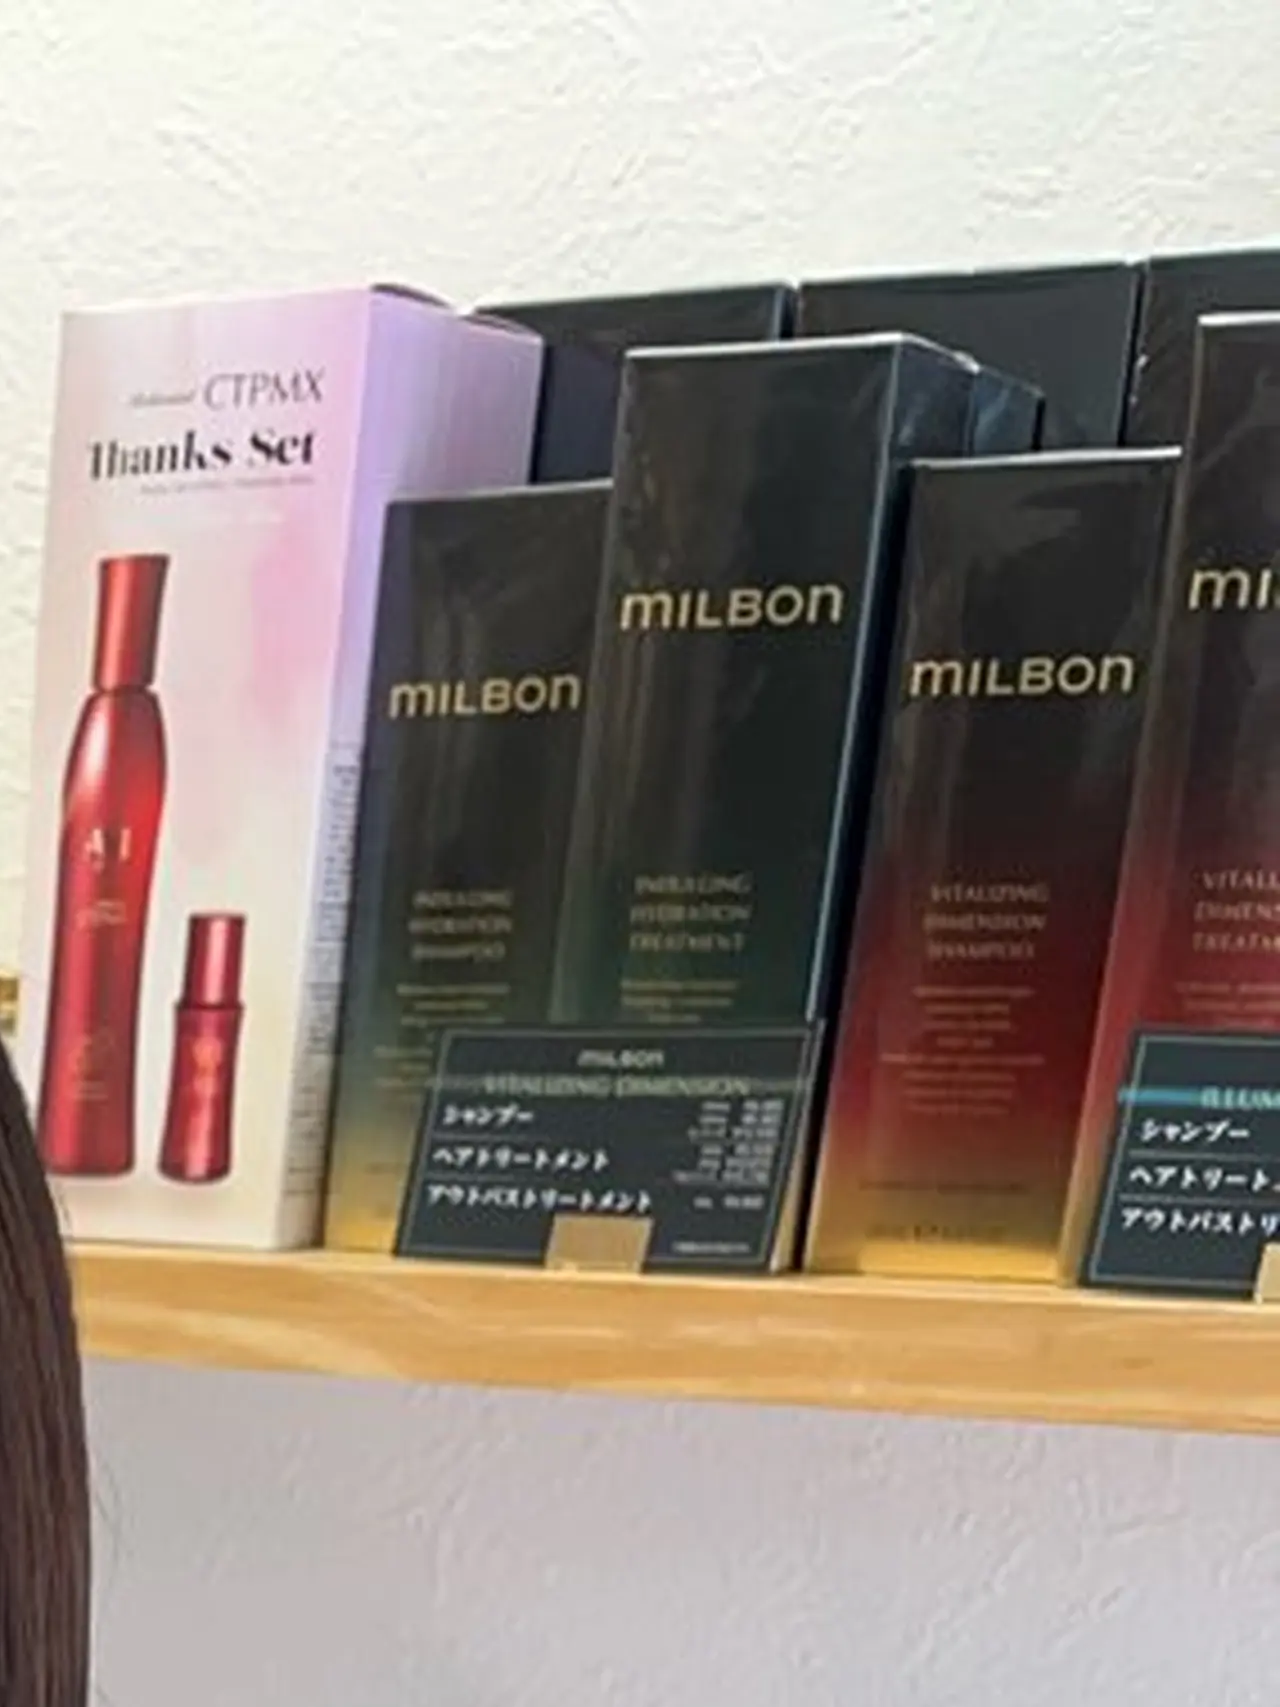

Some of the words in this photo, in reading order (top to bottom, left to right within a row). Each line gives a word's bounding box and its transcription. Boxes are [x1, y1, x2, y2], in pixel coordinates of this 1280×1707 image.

[89, 429, 234, 482] Thanks
[248, 427, 316, 467] Set
[1128, 1164, 1280, 1194] ヘアトリート
